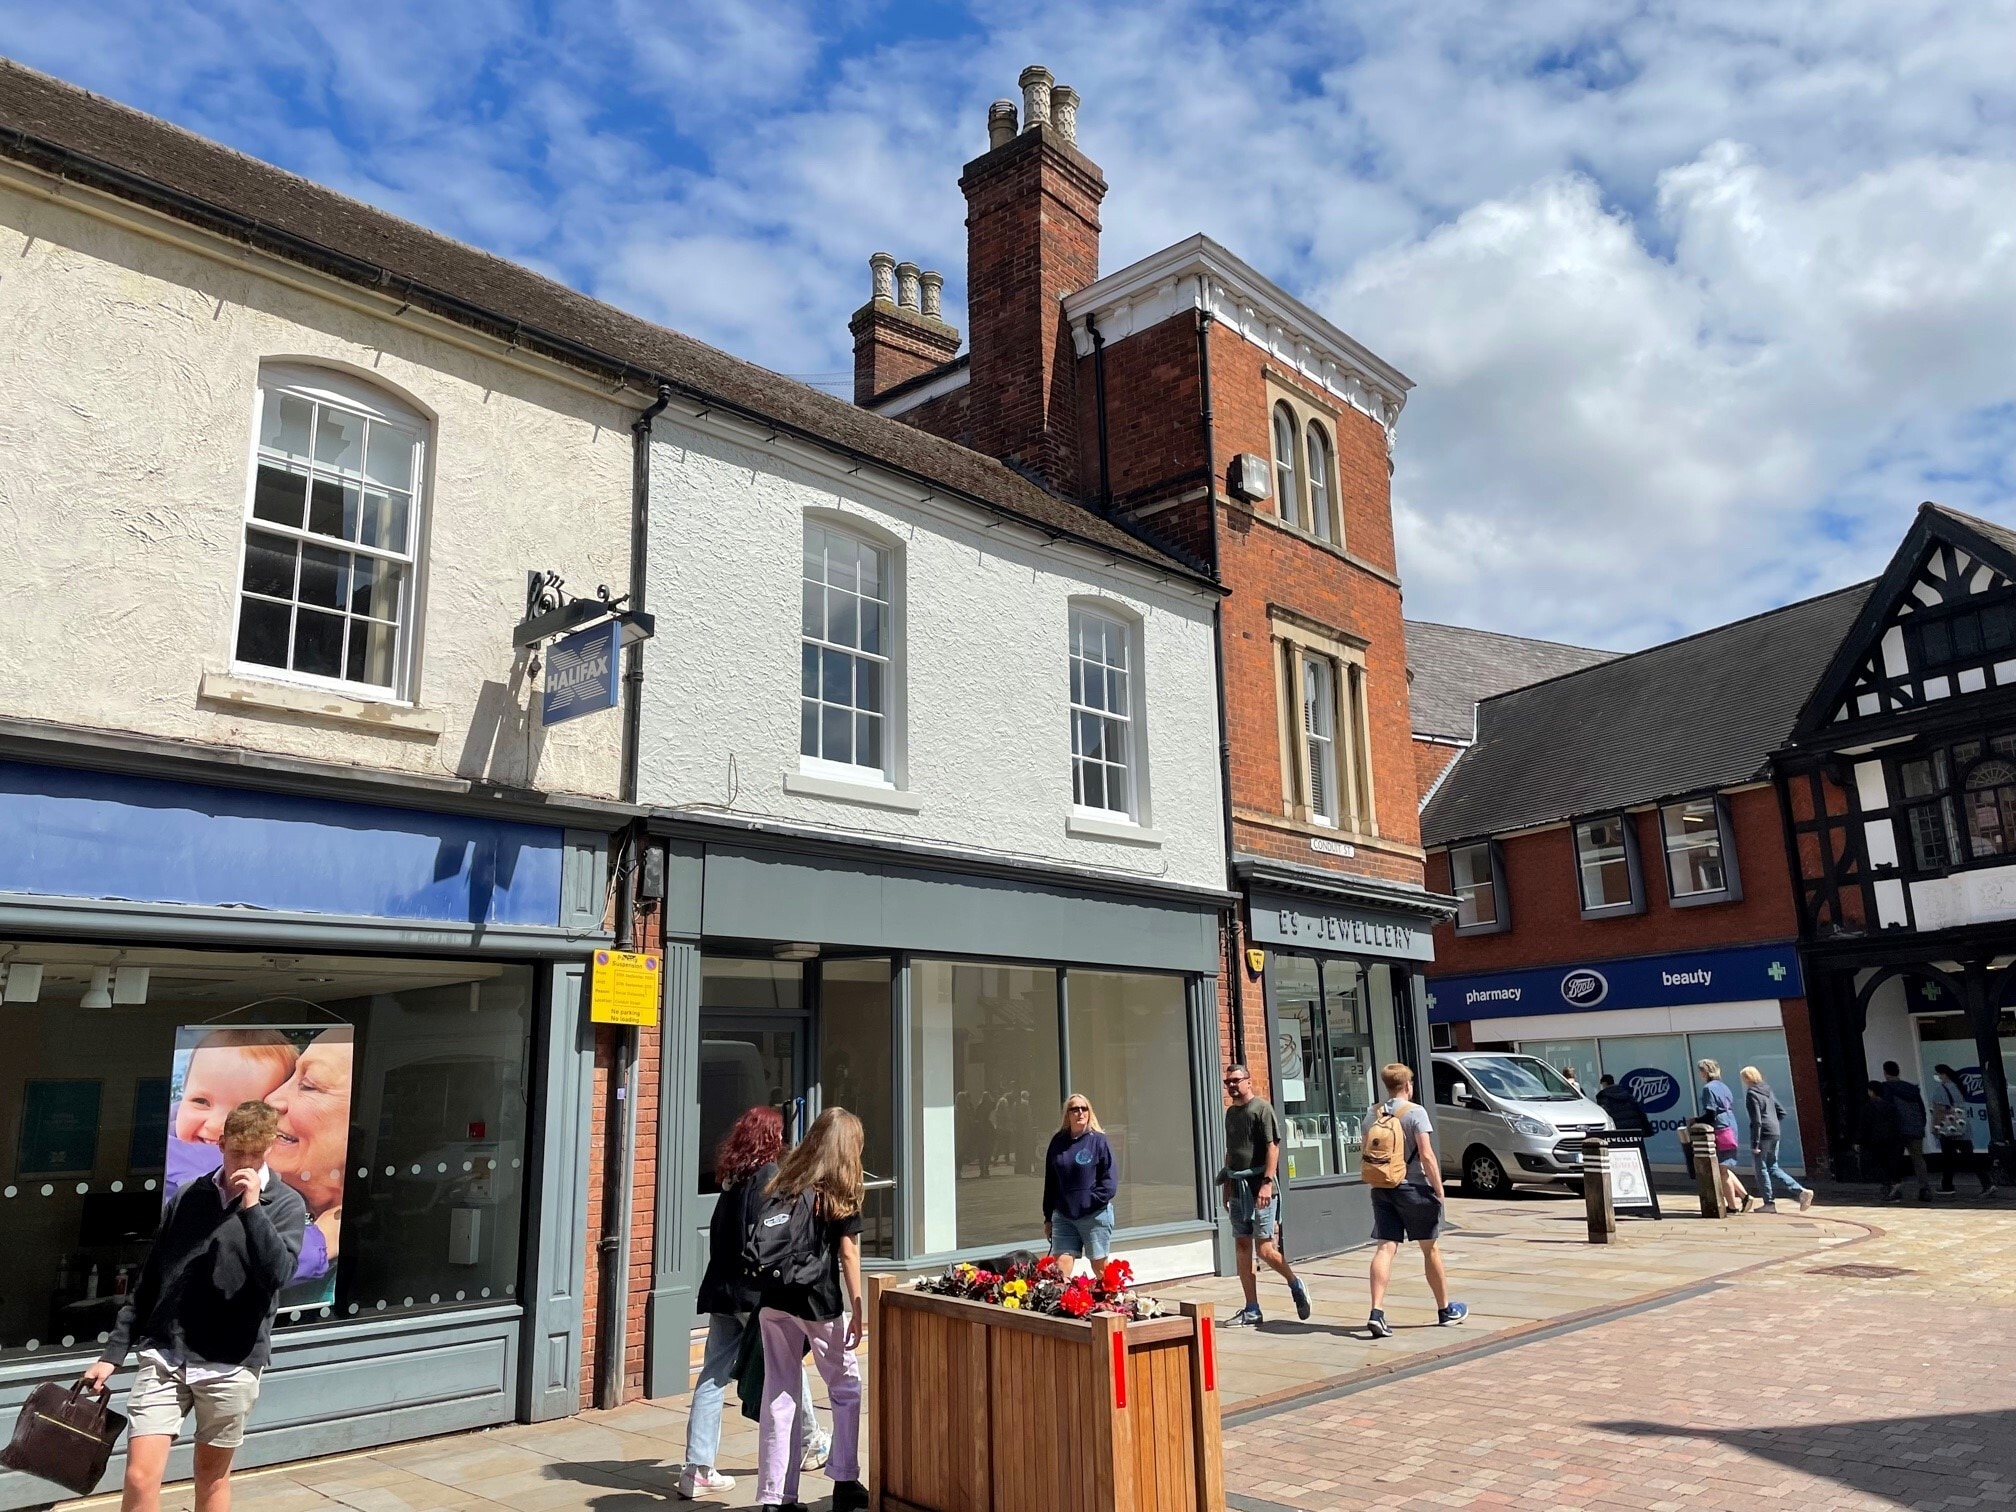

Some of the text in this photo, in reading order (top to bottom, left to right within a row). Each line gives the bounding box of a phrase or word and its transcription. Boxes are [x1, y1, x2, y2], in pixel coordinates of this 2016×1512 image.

[547, 655, 609, 693] HALIFAX
[1313, 839, 1342, 854] CONDUIT
[1279, 909, 1414, 950] ES JEWELLERY
[612, 960, 643, 969] Suspension
[1662, 968, 1712, 986] beauty
[1466, 987, 1522, 1005] pharmacy
[1566, 977, 1596, 999] Boots
[1628, 1075, 1671, 1105] Boots
[1650, 1116, 1687, 1134] good
